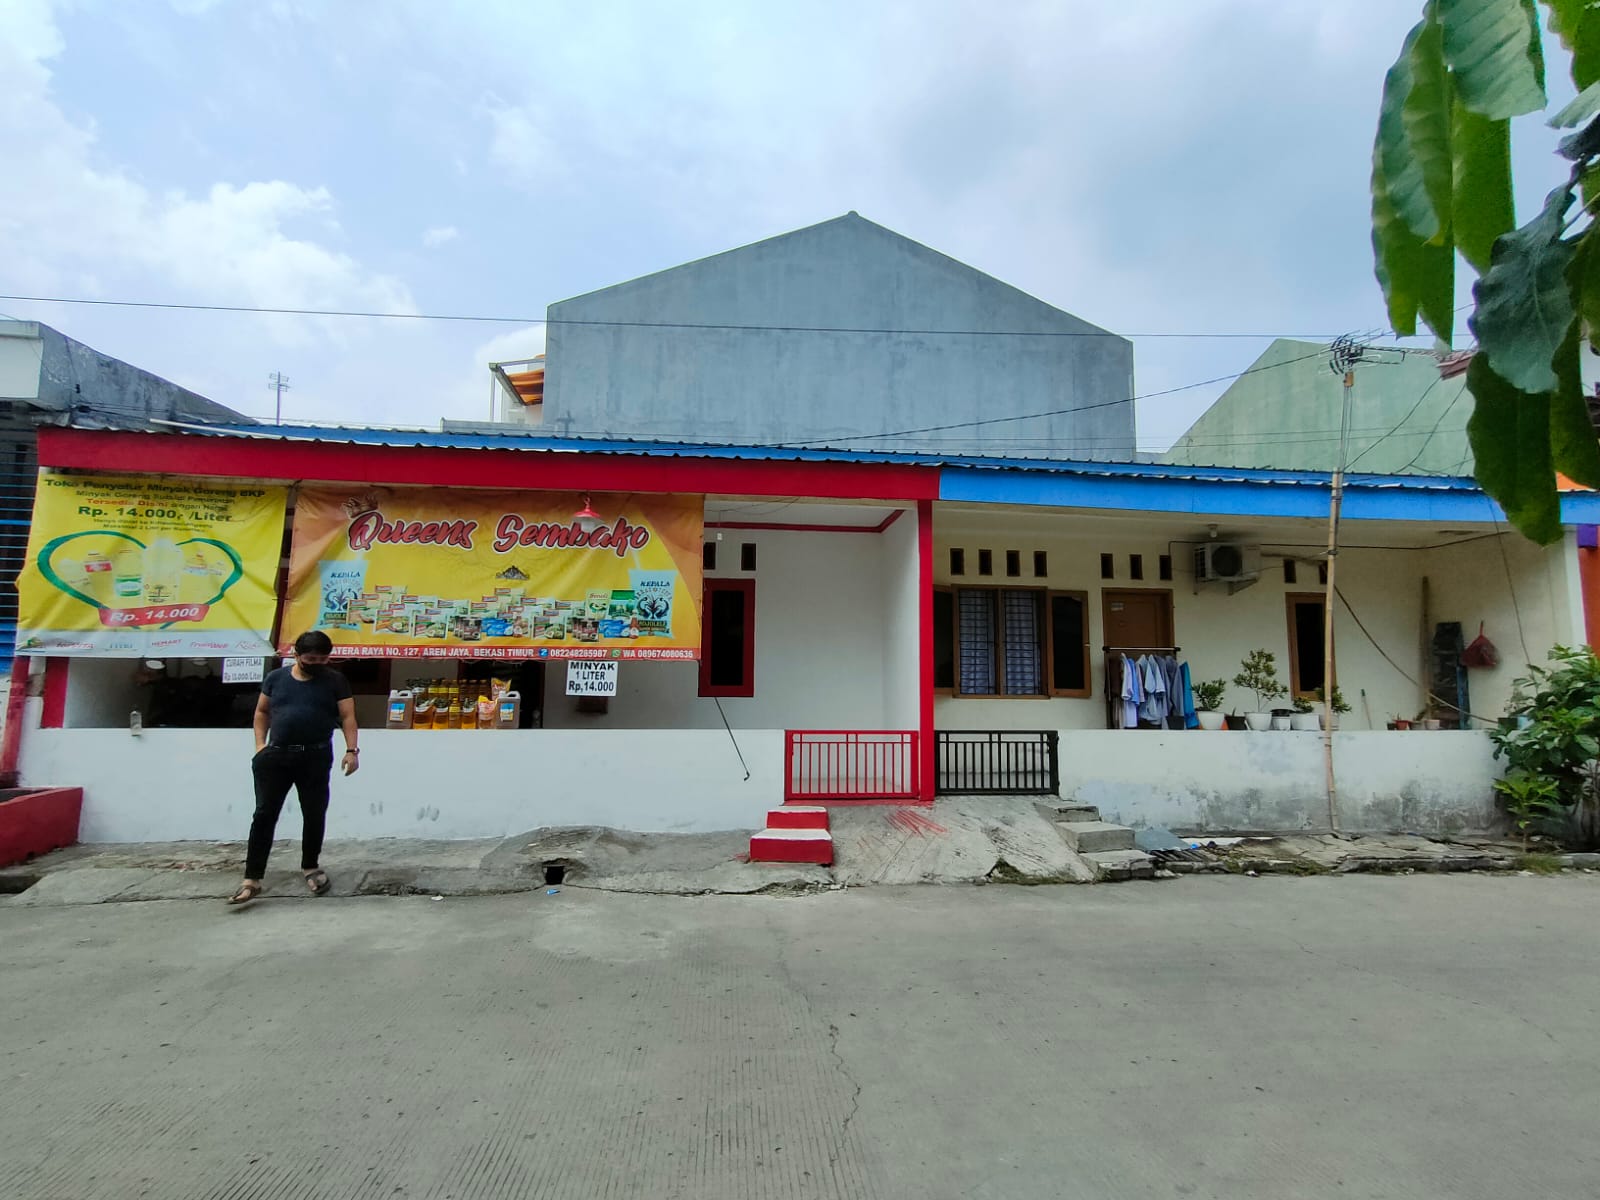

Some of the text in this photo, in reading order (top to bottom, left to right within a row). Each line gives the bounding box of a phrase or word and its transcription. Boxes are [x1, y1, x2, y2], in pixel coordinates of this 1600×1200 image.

[44, 479, 78, 488] Toko
[147, 484, 190, 493] Minyak
[76, 490, 110, 498] Minyak
[114, 492, 150, 500] Goreng
[78, 506, 108, 517] Rp.
[348, 510, 650, 557] Queens Sembako
[110, 607, 200, 622] Rp. 14.000
[330, 646, 360, 655] ATERA
[361, 646, 384, 655] RAYA
[386, 647, 401, 656] NO.
[422, 647, 447, 656] AREN
[474, 648, 505, 657] BEKASI
[507, 648, 534, 657] TIMUR
[623, 650, 636, 658] WA
[570, 661, 615, 670] MINYAK
[575, 671, 606, 680] 1 LITER
